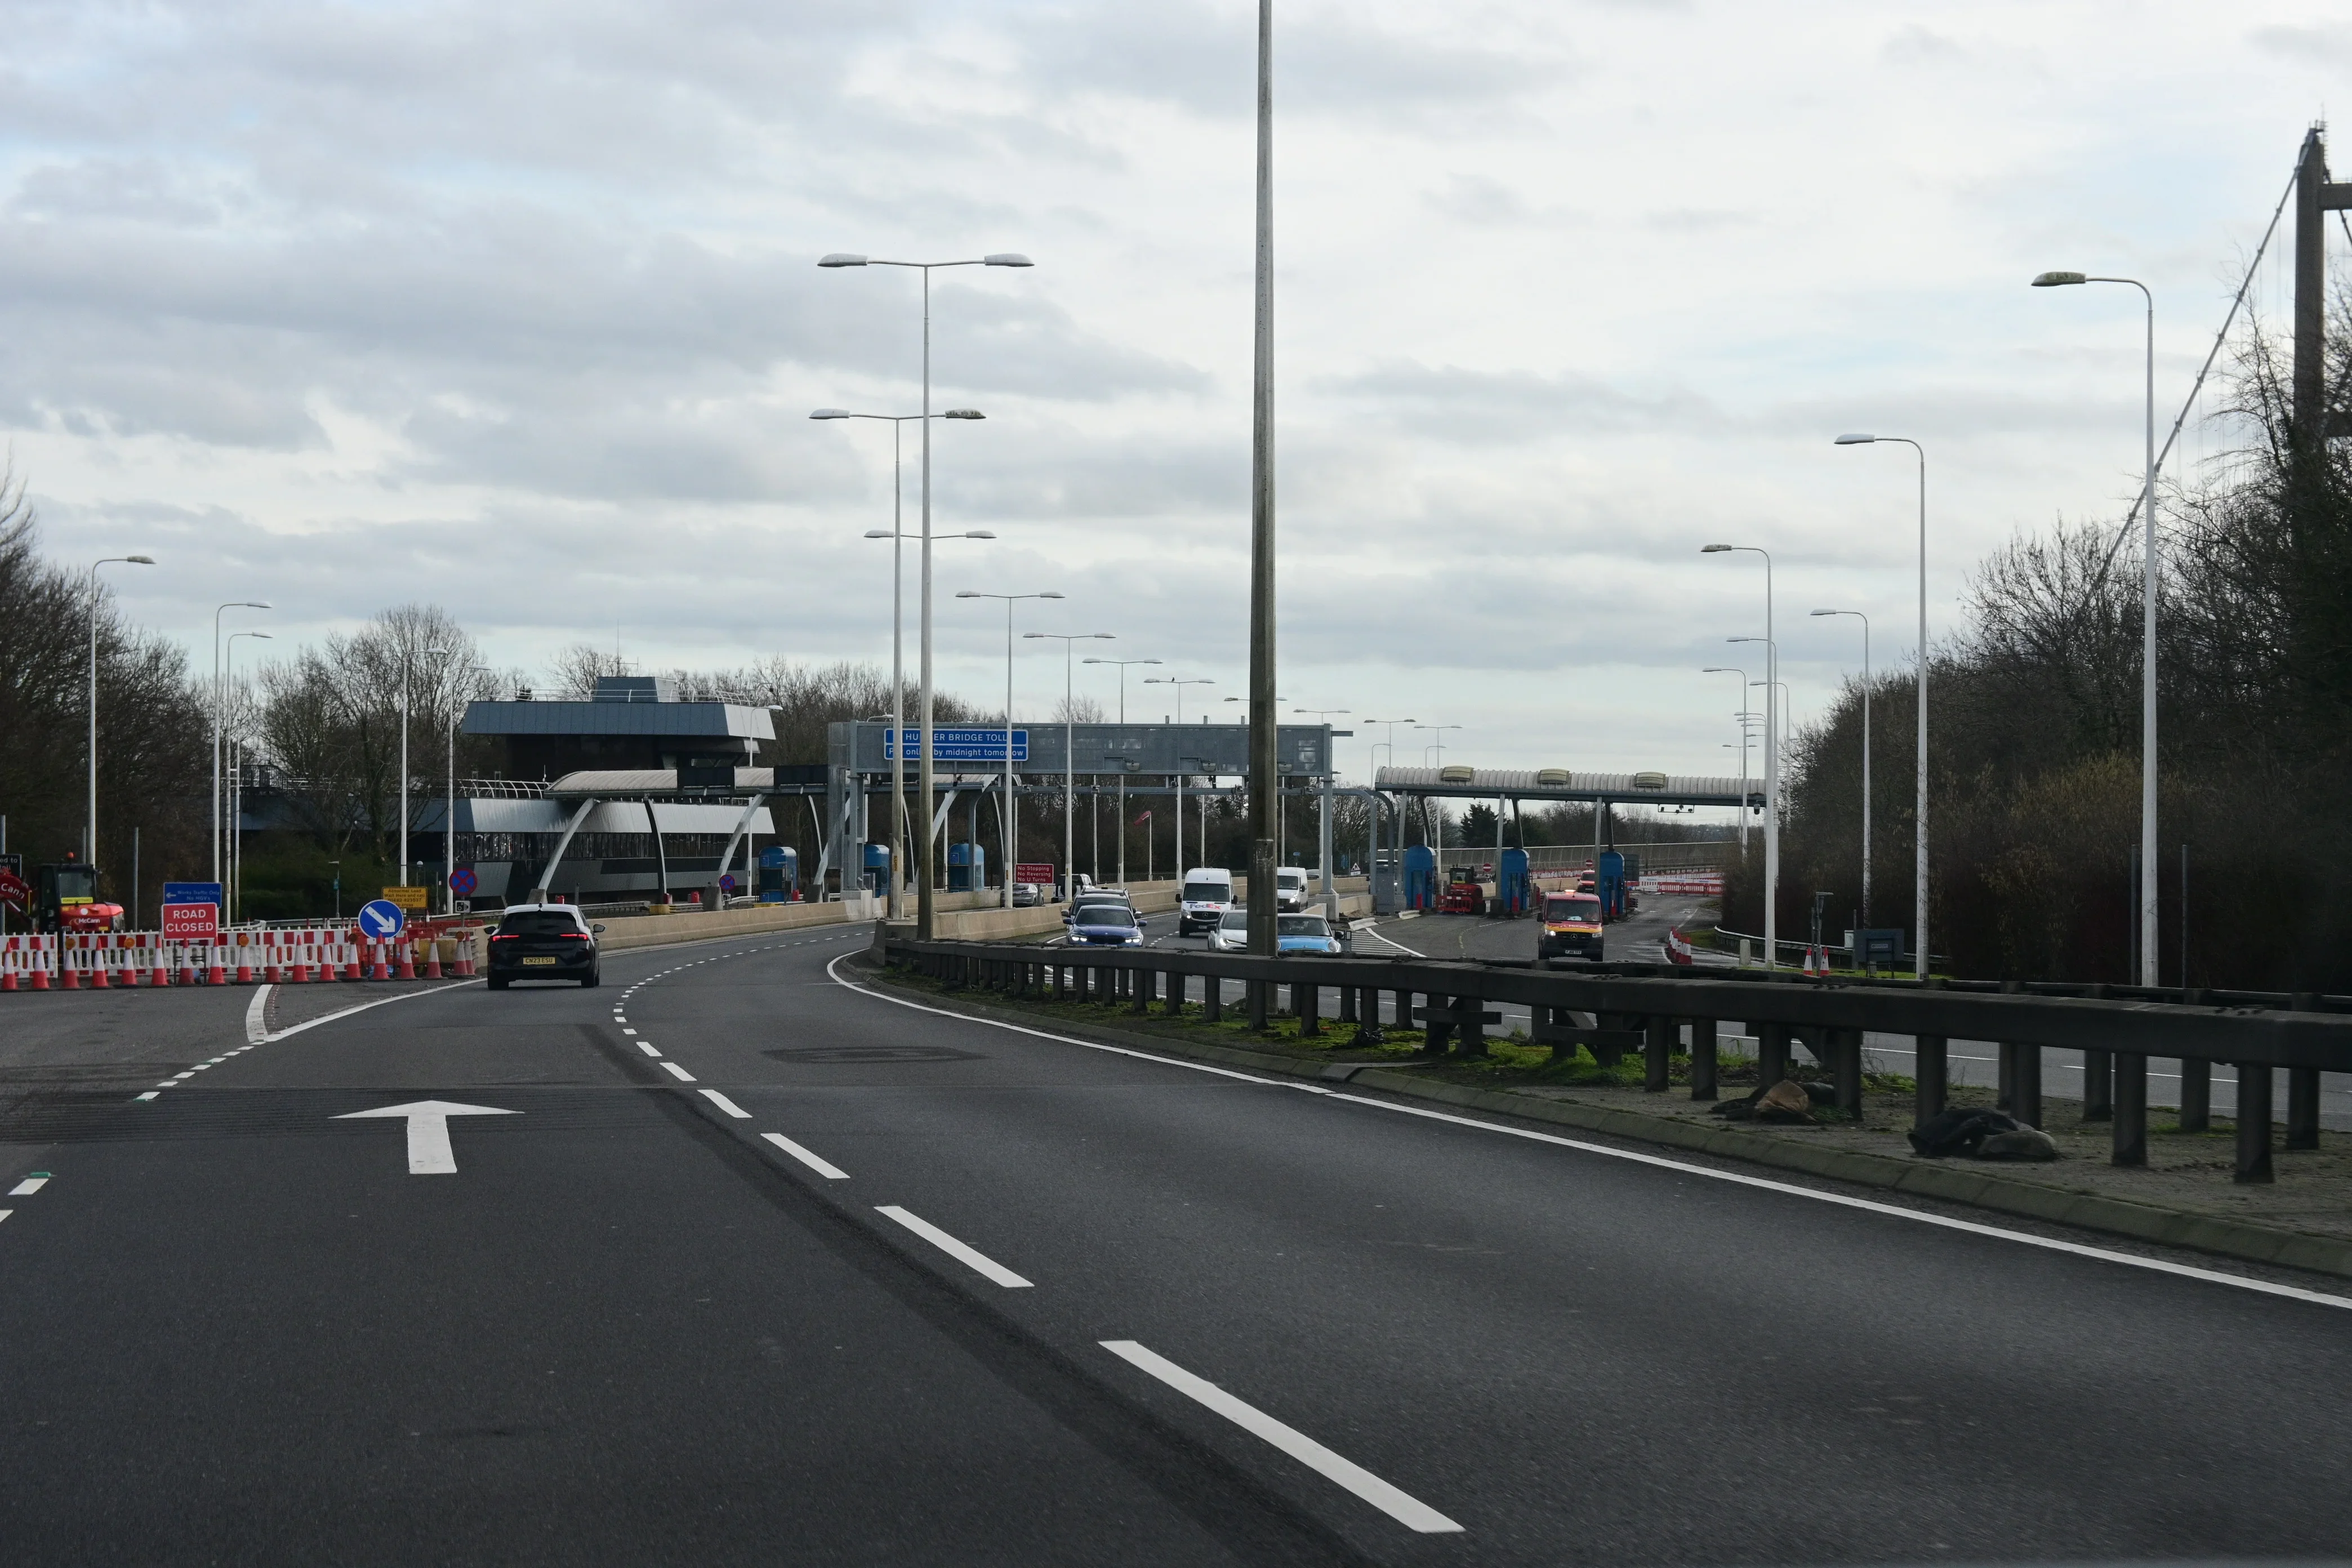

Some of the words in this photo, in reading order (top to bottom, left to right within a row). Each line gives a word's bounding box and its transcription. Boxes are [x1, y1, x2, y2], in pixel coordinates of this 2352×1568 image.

[934, 748, 943, 757] by
[946, 748, 981, 757] midnight
[173, 909, 206, 919] ROAD
[166, 922, 213, 932] CLOSED
